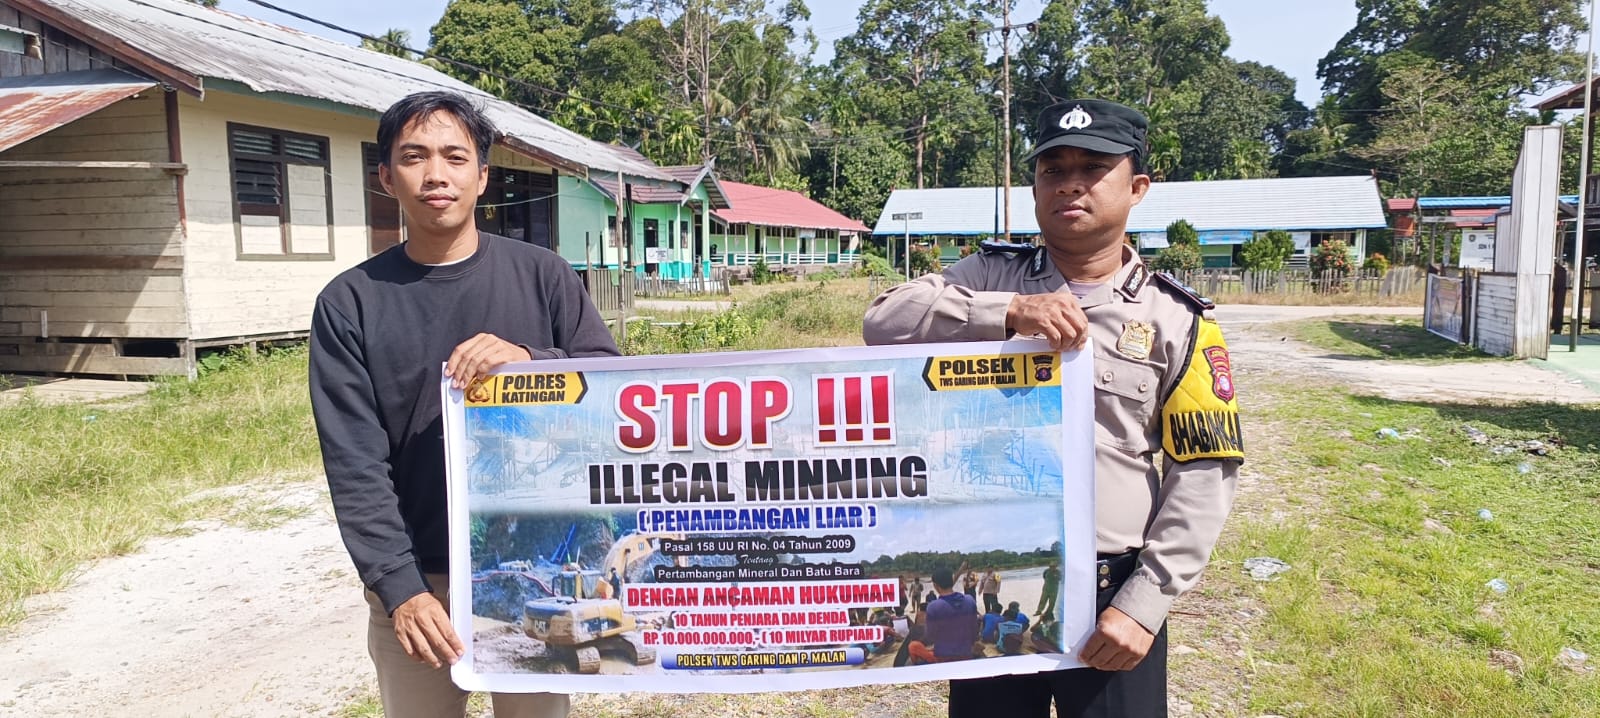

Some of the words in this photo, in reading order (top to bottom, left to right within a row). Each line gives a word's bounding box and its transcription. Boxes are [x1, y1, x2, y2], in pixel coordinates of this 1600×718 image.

[939, 358, 1015, 375] POLSEK
[502, 374, 566, 390] POLRES
[940, 377, 953, 387] TWS
[502, 390, 565, 403] KATINGAN
[618, 379, 788, 449] STOP
[817, 375, 891, 443] !!!
[588, 461, 734, 504] ILLEGAL
[745, 456, 928, 501] MINNING
[652, 507, 810, 532] PENAMBANGAN
[815, 506, 863, 528] LIAR
[664, 541, 693, 552] Pasal
[697, 541, 715, 551] 158
[718, 541, 734, 551] UU
[737, 541, 749, 551] RI
[751, 540, 770, 550] No.
[773, 540, 786, 550] 04
[788, 540, 822, 550] Tahun
[825, 539, 851, 549] 2009
[740, 554, 774, 566] Tentang
[658, 569, 735, 580] Pertambangan
[738, 567, 778, 578] Mineral
[781, 567, 802, 577] Dan
[806, 567, 831, 577] Batu
[834, 566, 860, 576] Bara
[627, 587, 699, 606] DENGAN
[703, 587, 795, 607] ANCAMAN
[799, 584, 895, 605] HUKUMAN
[674, 613, 688, 627] 10
[690, 613, 727, 626] TAHUN
[730, 612, 779, 626] PENJARA
[782, 612, 806, 625] DAN
[808, 611, 847, 625] DENDA
[643, 632, 659, 645] RP.
[769, 631, 782, 644] 10
[786, 630, 827, 643] MILYAR
[830, 628, 873, 642] RUPIAH
[677, 654, 713, 667] POLSEK
[716, 654, 738, 666] TWS
[741, 653, 776, 666] GARING
[779, 652, 799, 665] DAN
[801, 652, 809, 664] P.
[811, 651, 846, 663] MALAN
